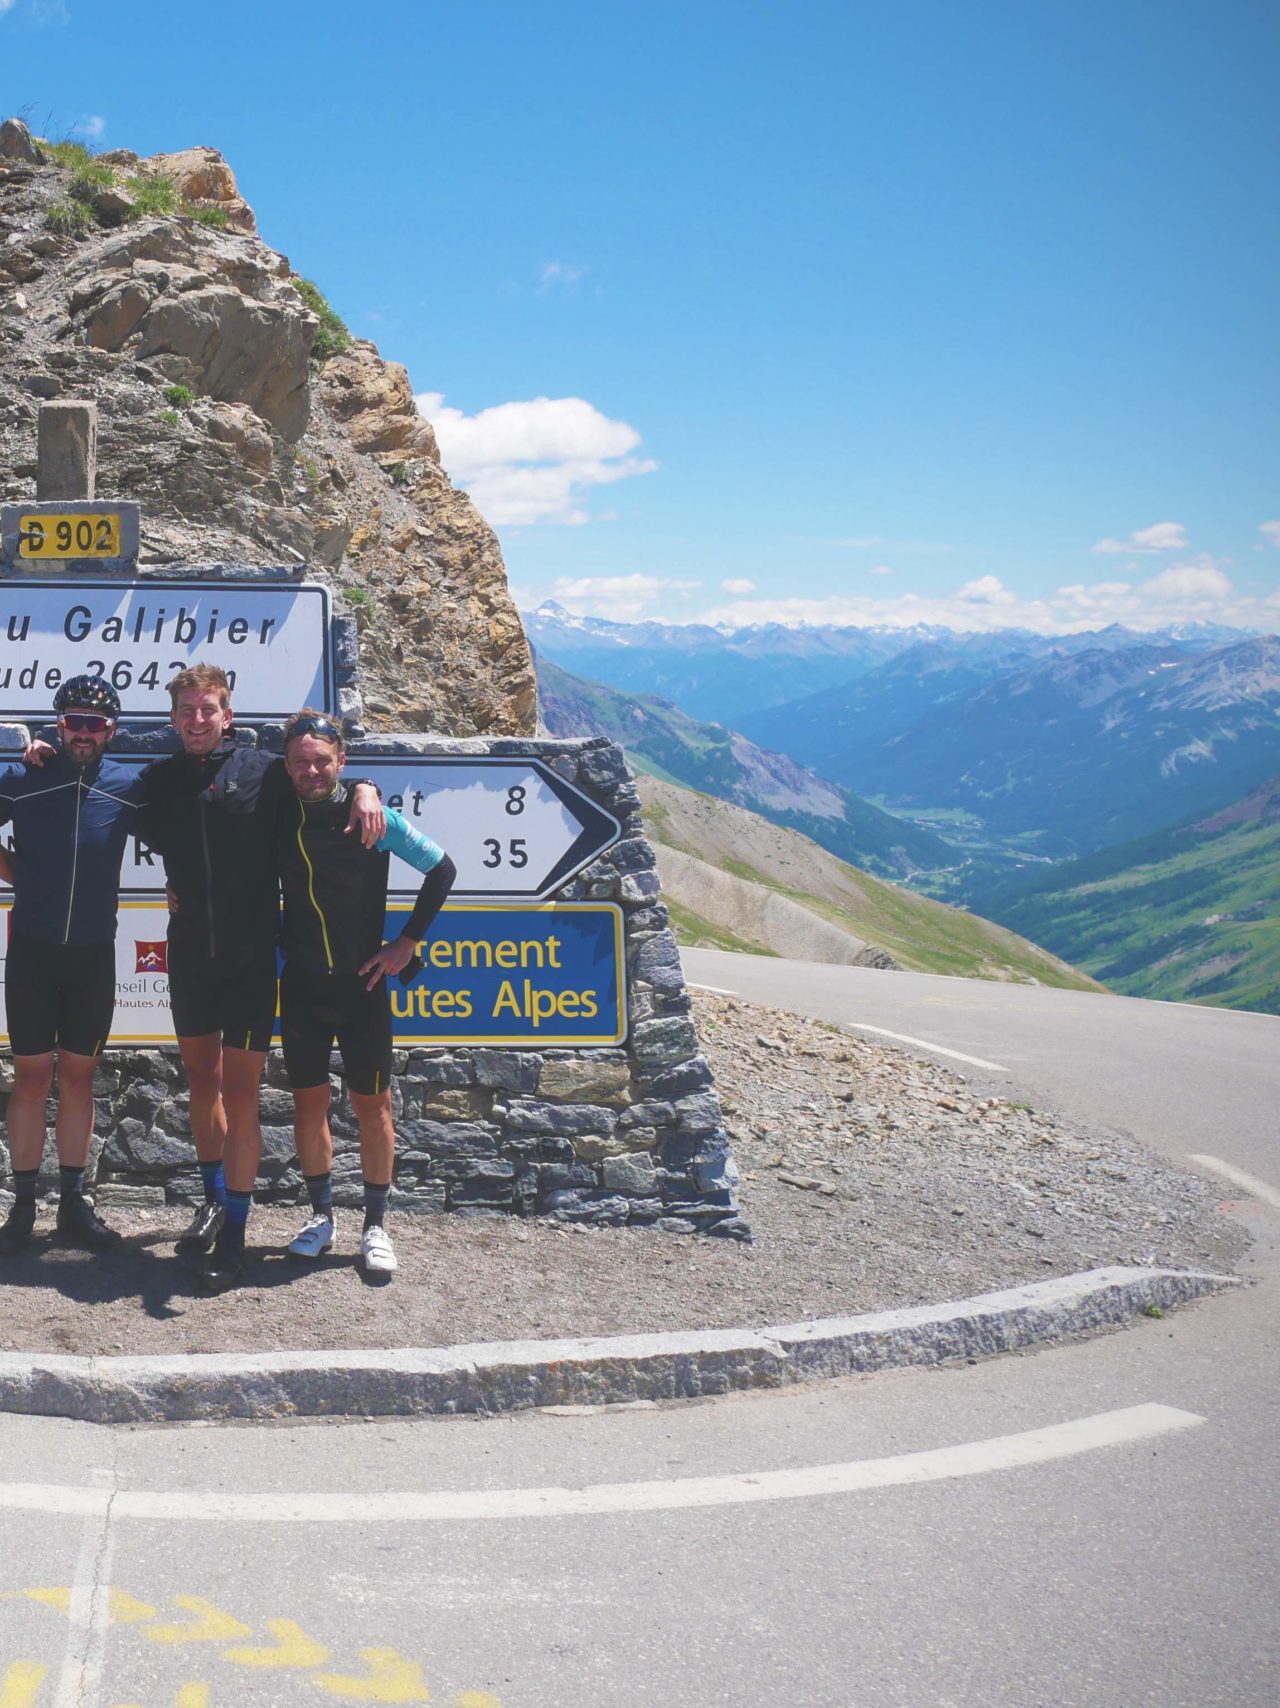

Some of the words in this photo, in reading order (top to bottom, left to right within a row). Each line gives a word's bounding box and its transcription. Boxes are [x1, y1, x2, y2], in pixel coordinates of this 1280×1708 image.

[27, 521, 45, 552] D
[55, 520, 113, 552] 902
[63, 605, 277, 645] Galibier
[504, 785, 527, 816] 8
[482, 838, 529, 869] 35
[390, 984, 473, 1018] utes
[491, 978, 599, 1028] Alpes
